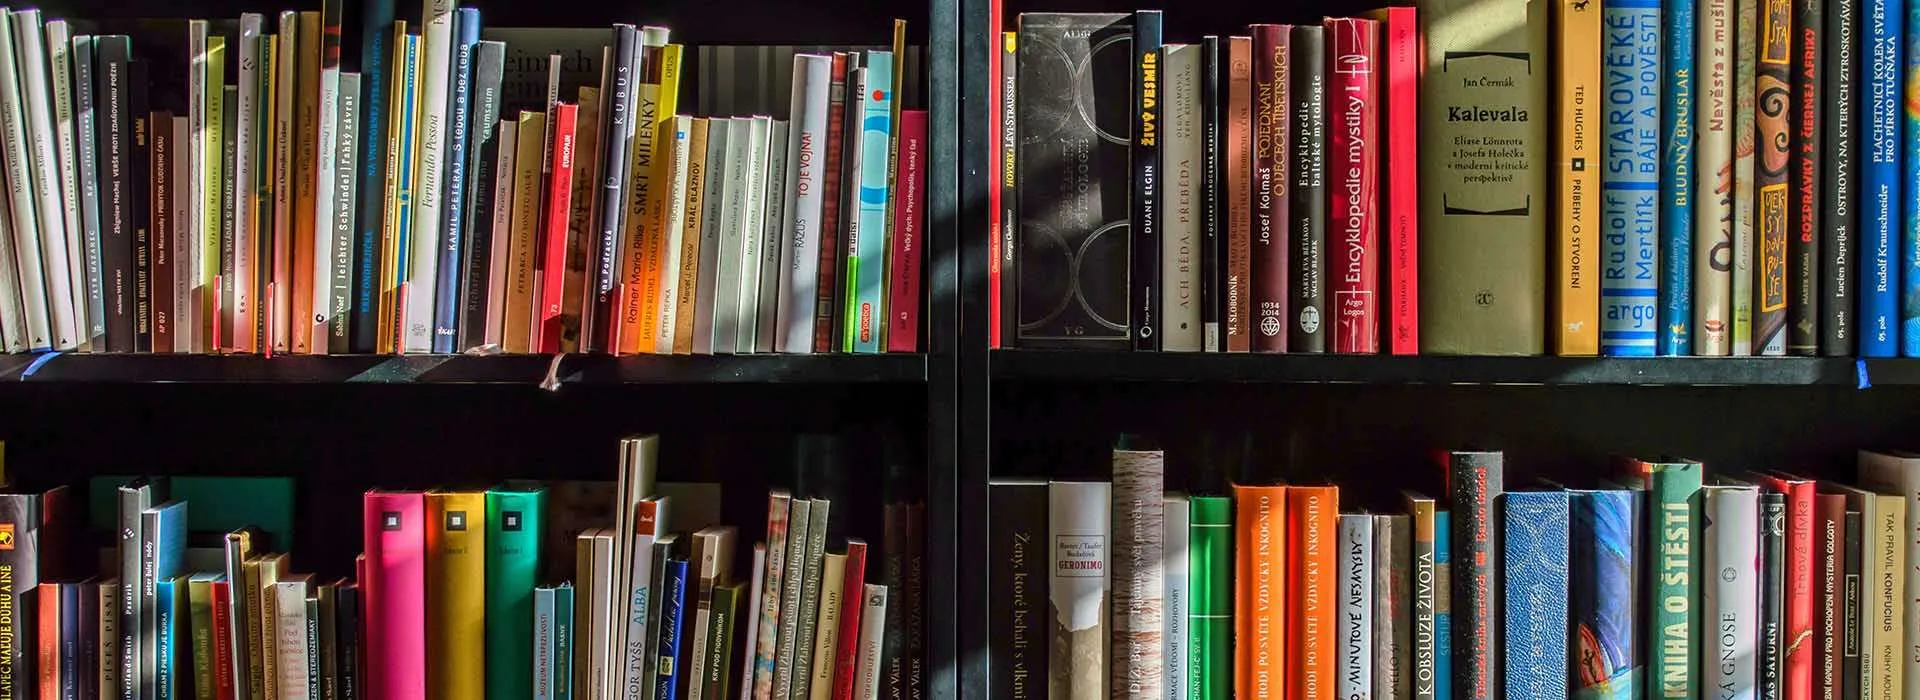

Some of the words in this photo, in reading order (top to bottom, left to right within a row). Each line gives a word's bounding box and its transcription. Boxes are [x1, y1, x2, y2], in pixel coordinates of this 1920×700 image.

[458, 44, 469, 69] teba
[1638, 14, 1657, 97] POVĚSTI
[1715, 47, 1724, 56] z
[1802, 28, 1815, 78] AFRIKY
[1874, 38, 1884, 80] KOLEM
[1884, 36, 1896, 97] TUČŇÁKA
[457, 73, 466, 93] bez
[615, 65, 628, 125] KUBUS
[1141, 52, 1156, 108] VESMÍR
[1463, 77, 1478, 89] Jan
[1479, 76, 1514, 88] Čermák
[1575, 84, 1584, 105] TED
[1605, 14, 1635, 173] STAROVĚKÉ
[1709, 62, 1724, 132] Nevěsta
[109, 88, 118, 130] ZDAŇOVANIU
[342, 96, 353, 130] závrat
[1258, 82, 1272, 158] POJEDNANÍ
[1312, 75, 1322, 138] mytologie
[1448, 106, 1528, 123] Kalevala
[1640, 106, 1656, 118] A
[1674, 68, 1689, 138] BRUSLAŘ
[1800, 83, 1814, 137] ČIERNEJ
[1837, 84, 1849, 138] KTERÝCH
[1884, 99, 1895, 136] PÍRKO
[423, 115, 438, 153] Pessoa
[454, 107, 466, 140] tebou
[638, 98, 656, 167] MILENKY
[1141, 112, 1155, 146] ŽIVÝ
[1347, 96, 1363, 163] mystiky
[1574, 108, 1584, 151] HUGHES
[1872, 82, 1884, 163] PLACHETNICÍ
[156, 136, 165, 153] ČASU
[453, 143, 462, 152] S
[562, 134, 571, 168] EUROPAIN
[800, 132, 812, 169] VOJNA!
[1298, 102, 1310, 186] Encyklopedie
[1454, 136, 1480, 146] Eliase
[1482, 136, 1523, 146] Lönnrota
[1459, 148, 1486, 159] Josefa
[1488, 148, 1524, 159] Holečka
[1639, 129, 1657, 173] BÁJE
[1802, 143, 1813, 152] Z
[1838, 139, 1847, 157] NA
[1885, 139, 1895, 163] PRO
[111, 156, 119, 177] VERŠE
[421, 154, 436, 208] Fernando
[800, 172, 811, 181] JE
[1005, 153, 1015, 187] HOVORY
[1144, 165, 1153, 195] ELGIN
[1311, 142, 1322, 186] baltské
[111, 180, 121, 204] Machej
[226, 178, 235, 210] OBRÁZEK
[339, 174, 350, 230] Schwindel
[450, 162, 460, 210] PETERAJ
[633, 173, 649, 216] SMRŤ
[798, 183, 808, 198] TO
[1178, 159, 1190, 223] PŘEBĚDA
[1258, 168, 1271, 209] Kolmaš
[1274, 184, 1286, 196] O
[1800, 157, 1814, 242] ROZPRÁVKY
[1837, 159, 1848, 216] OSTROVY,
[112, 205, 121, 234] Zbigniew
[448, 215, 458, 251] KAMIL
[1144, 199, 1153, 234] DUANE
[1259, 214, 1271, 245] Josef
[1345, 168, 1363, 283] Encyklopedie
[1572, 224, 1580, 234] O
[1878, 184, 1888, 257] Krautschneider
[225, 220, 234, 252] SKLÁDÁM
[601, 230, 613, 275] Podracká
[635, 225, 645, 249] Rilke
[1179, 231, 1191, 272] BĚDA,
[1606, 194, 1626, 280] Rudolf
[1634, 195, 1654, 280] Mertlík
[338, 236, 348, 279] leichter
[631, 251, 643, 285] Maria
[1302, 256, 1310, 270] EVA
[1310, 239, 1318, 269] BLAŽEK
[1571, 236, 1582, 290] STVORENÍ
[518, 251, 527, 294] PETRARCA
[1302, 272, 1310, 297] MARTA
[1310, 271, 1318, 297] VÁCLAV
[1835, 266, 1846, 297] Lucien
[1877, 259, 1888, 292] Rudolf
[599, 278, 608, 302] Dana
[627, 284, 640, 324] Rainer
[1179, 280, 1190, 309] ACH
[1227, 275, 1238, 323] SLOBODNÍK
[1261, 301, 1280, 310] 1934
[1345, 299, 1363, 308] Argo
[662, 313, 671, 338] PETER
[1261, 308, 1280, 316] 2014
[1344, 308, 1365, 317] Logos
[1607, 305, 1655, 328] argo
[1837, 311, 1846, 326] pole
[1878, 316, 1886, 329] pole
[1229, 325, 1237, 336] M.
[1131, 499, 1142, 542] pravěku
[1259, 496, 1270, 555] INKOGNITO
[1307, 496, 1318, 556] INKOGNITO
[1476, 508, 1486, 542] Bardo
[1826, 520, 1835, 554] GOLGOTY
[1886, 513, 1894, 532] TAK
[1011, 532, 1031, 569] Ženy,
[1661, 502, 1689, 586] ŠTĚSTÍ
[1886, 535, 1894, 570] PRAVIL
[1059, 560, 1102, 570] GERONIMO
[1351, 540, 1363, 608] NESMYSLY
[1414, 552, 1431, 609] ŽIVOTA
[1826, 555, 1835, 593] MYSTERIA
[1014, 572, 1028, 606] ktoré
[1257, 560, 1270, 611] VŽDYCKY
[1307, 560, 1318, 611] VŽDYCKY
[1884, 573, 1893, 632] KONFUCIUS
[104, 594, 113, 631] PÍSNÍ
[633, 586, 647, 625] ALBA
[766, 595, 776, 612] Izby
[827, 590, 836, 620] BALADY
[1171, 588, 1179, 634] ROZHOVORY
[1664, 596, 1688, 613] O
[1825, 593, 1834, 636] POCHOPENÍ
[1014, 610, 1028, 648] behali
[1722, 612, 1736, 675] GNOSE
[1825, 637, 1833, 652] PRO
[103, 642, 113, 681] PÍSEŇ
[630, 641, 642, 672] TYŠŠ
[1170, 642, 1178, 673] VĚDOMÍ
[1259, 651, 1268, 666] PO
[1307, 651, 1317, 666] PO
[1419, 614, 1431, 681] OBSLUZE
[1664, 623, 1688, 697] KNIHA
[1766, 622, 1776, 678] SATURNI
[1883, 645, 1892, 667] KNIHY
[776, 667, 788, 697] Vyvrtil
[890, 657, 901, 684] VÁLEK
[910, 658, 921, 686] VÁLEK
[1014, 661, 1028, 699] vlkmi
[1824, 654, 1833, 685] KAMENY
[1419, 684, 1431, 695] K
